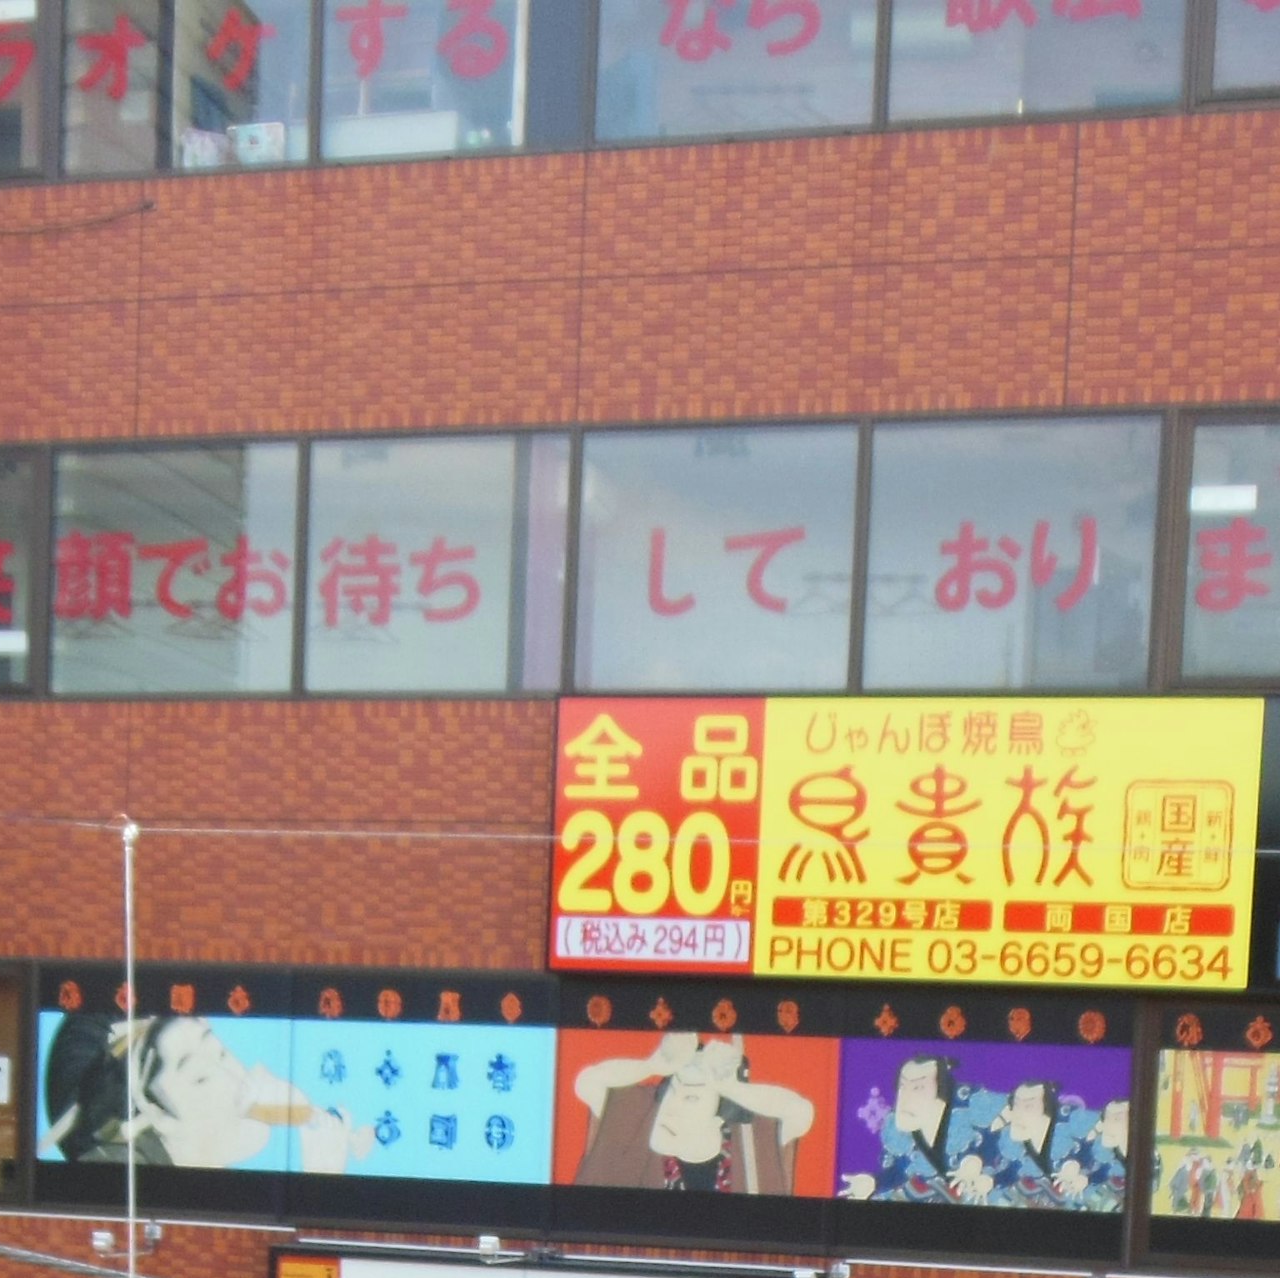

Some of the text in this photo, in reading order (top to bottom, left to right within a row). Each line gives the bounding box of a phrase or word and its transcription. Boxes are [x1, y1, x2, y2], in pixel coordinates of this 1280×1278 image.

[563, 712, 760, 803] 全品
[805, 709, 1045, 757] じゃんぼ焼鳥
[1153, 794, 1198, 878] 国産
[801, 898, 1194, 935] 第329号店 両国店
[768, 935, 1234, 985] PHONE 03-6659-6634
